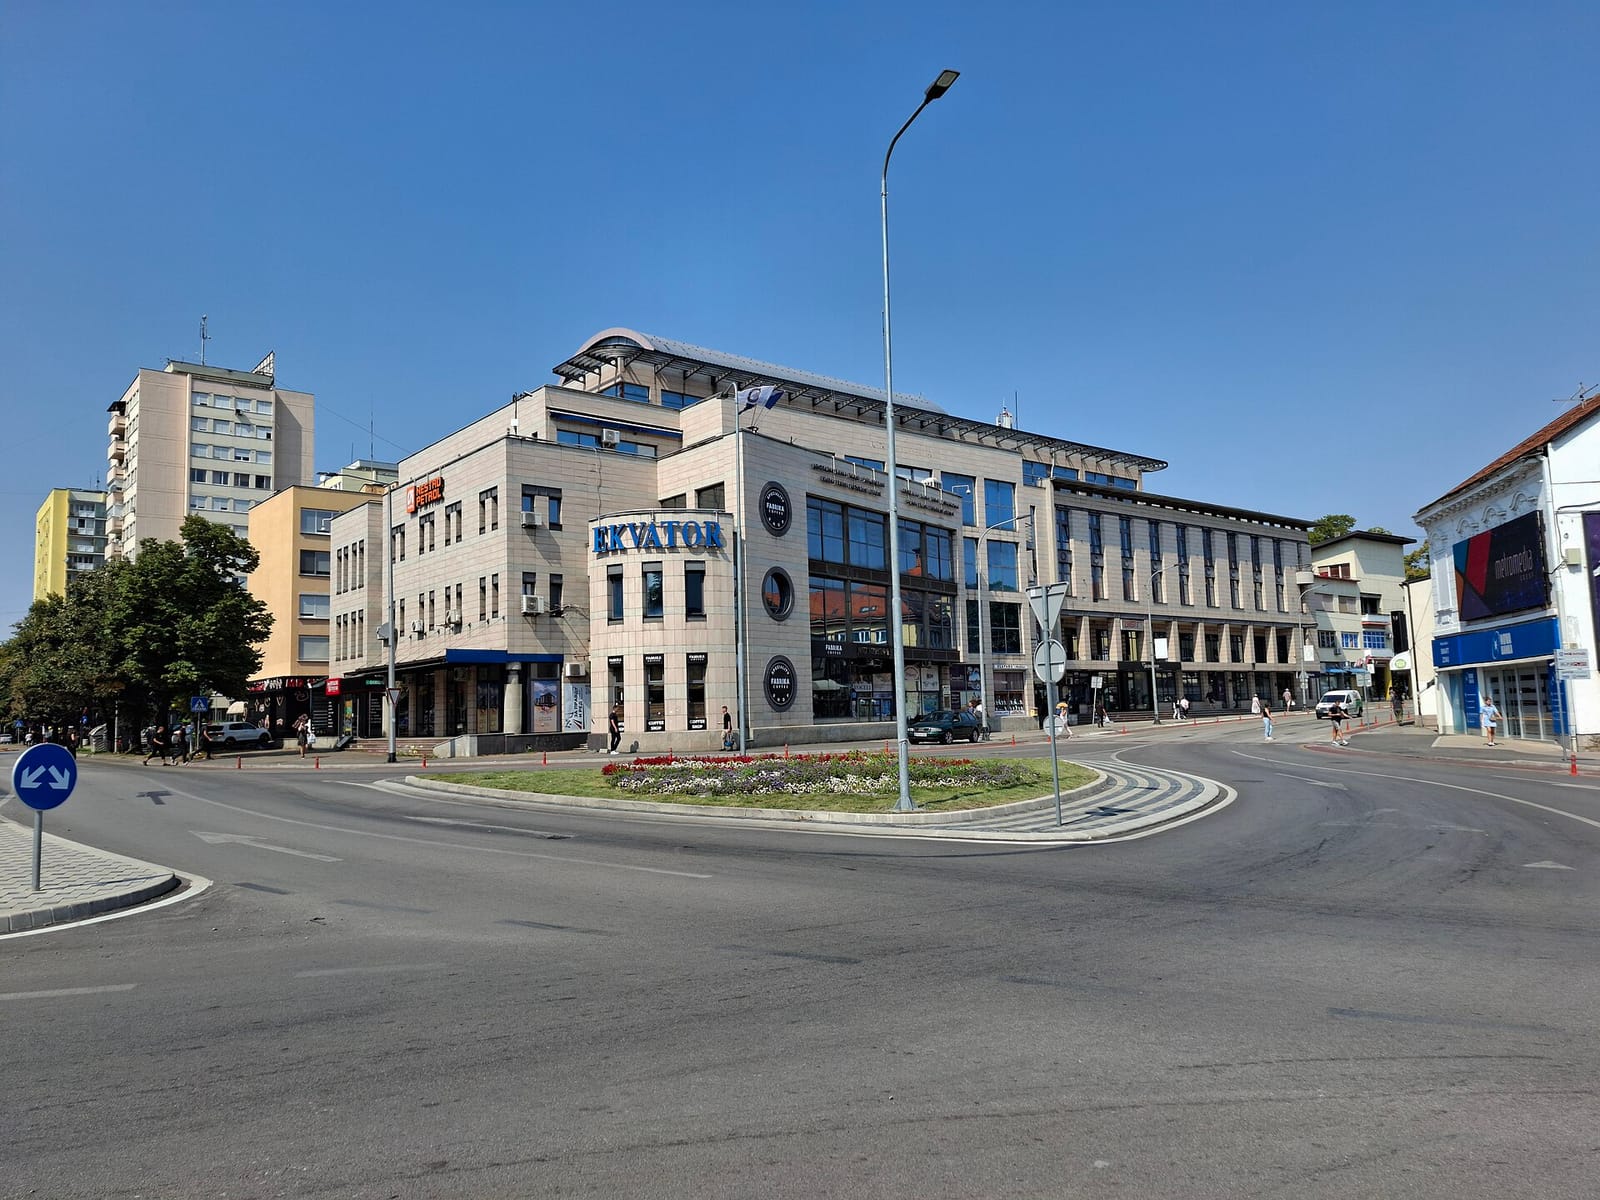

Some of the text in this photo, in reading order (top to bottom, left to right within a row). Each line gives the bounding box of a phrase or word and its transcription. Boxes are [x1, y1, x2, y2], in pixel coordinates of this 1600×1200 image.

[416, 488, 442, 507] PETROL
[592, 520, 725, 553] EKVATOR
[1495, 546, 1532, 580] metromedia
